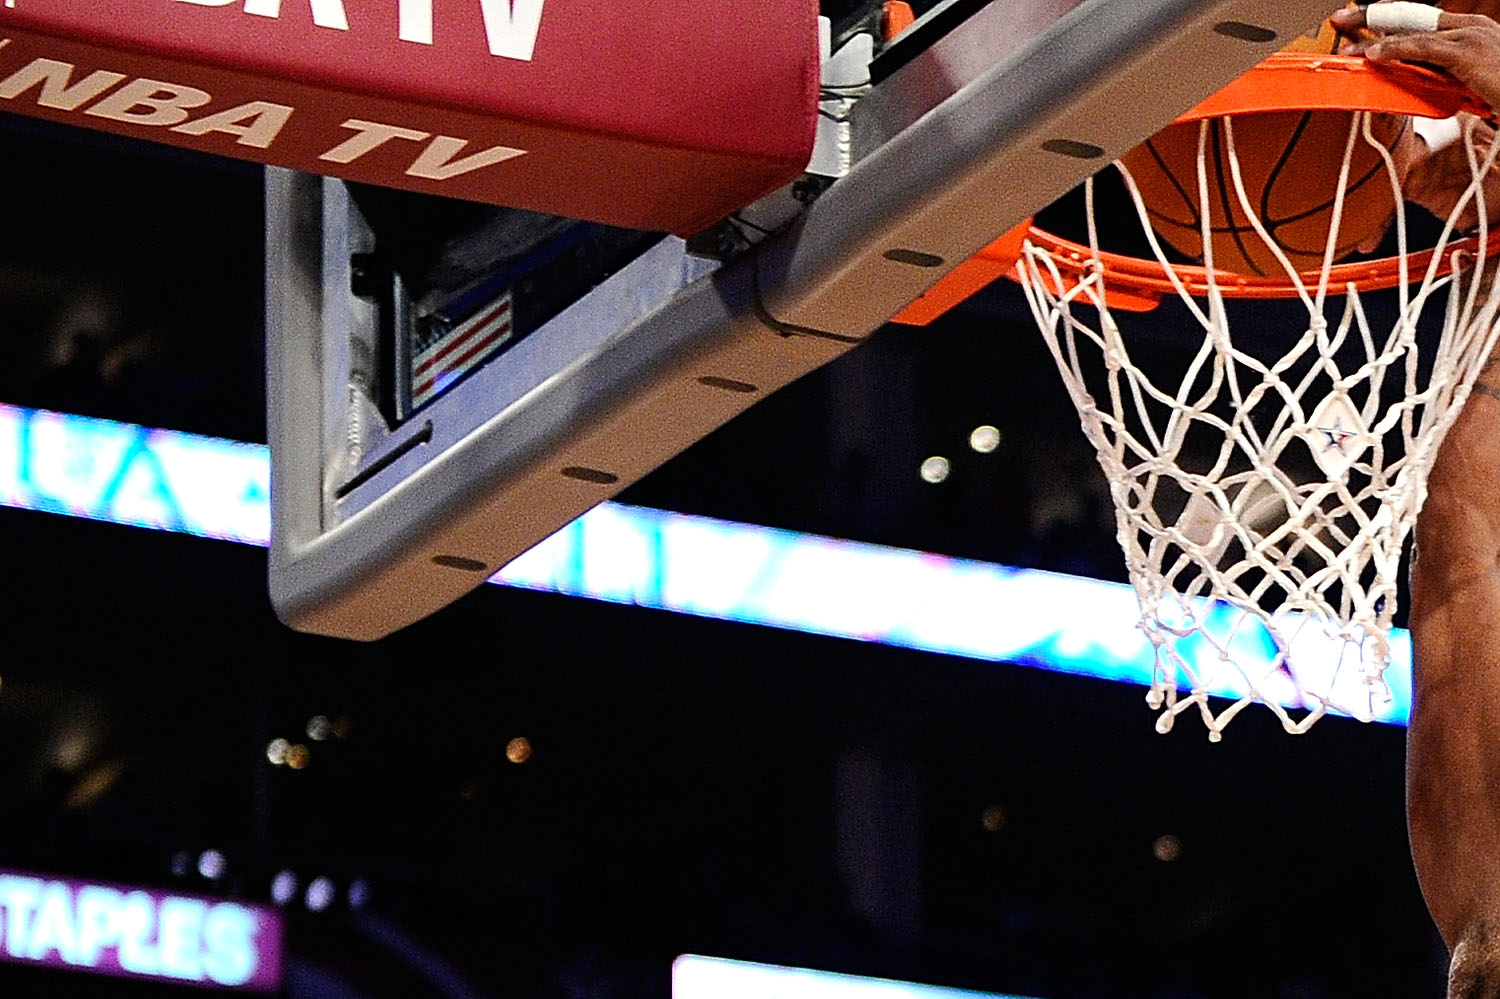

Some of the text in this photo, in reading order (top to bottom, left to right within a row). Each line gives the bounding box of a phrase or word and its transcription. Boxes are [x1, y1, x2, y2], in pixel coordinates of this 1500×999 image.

[0, 58, 528, 180] NBA TV
[0, 874, 257, 986] TAPLES
